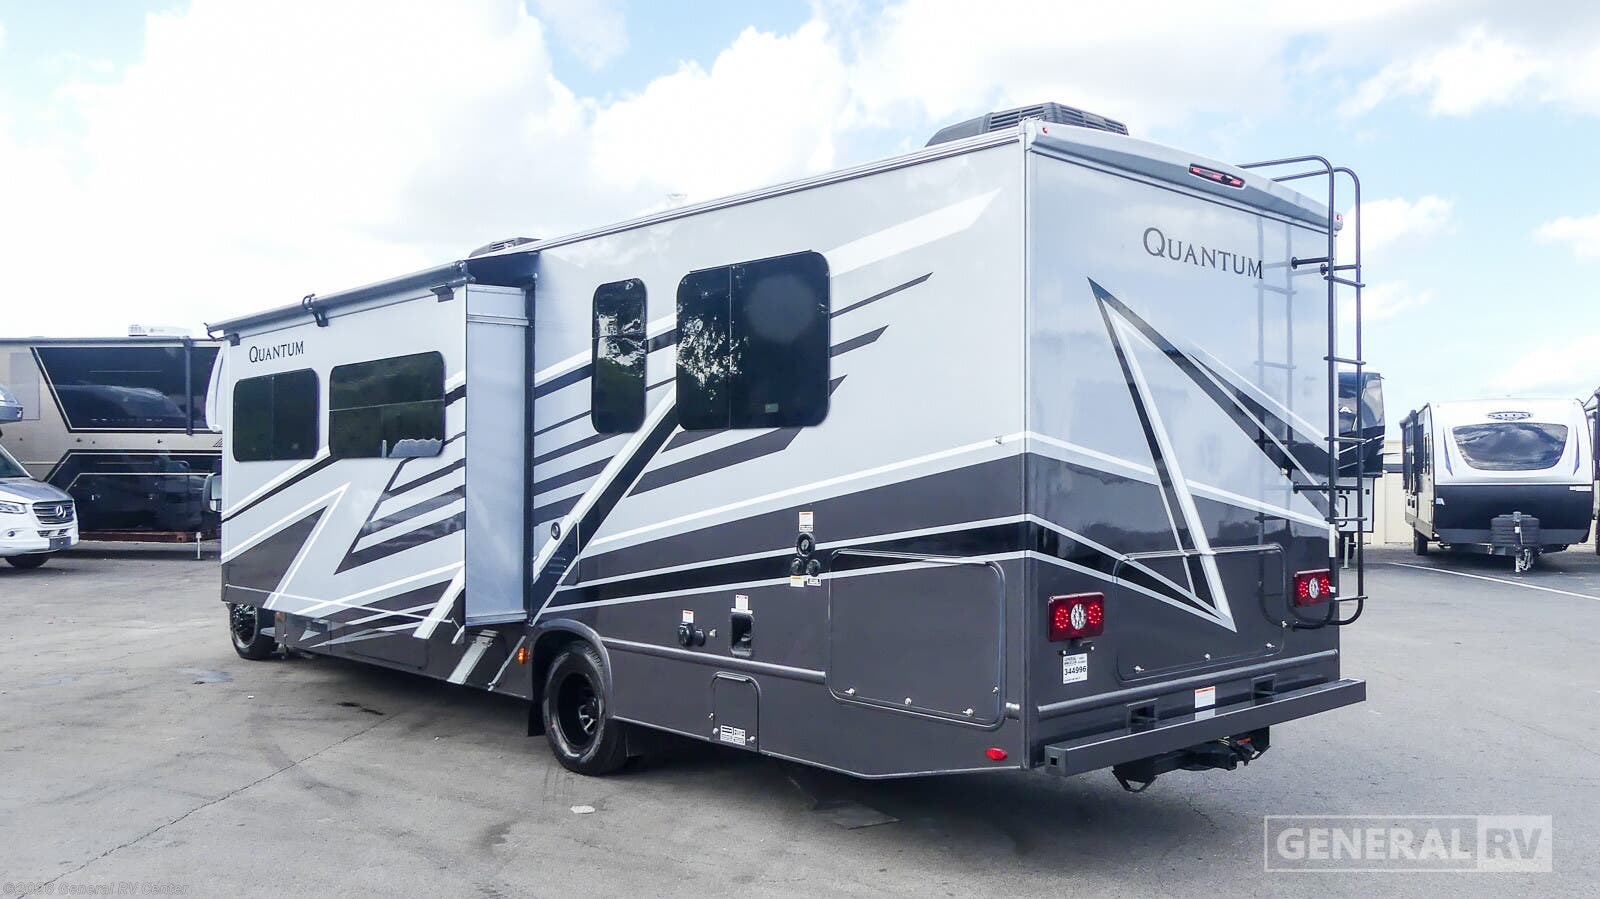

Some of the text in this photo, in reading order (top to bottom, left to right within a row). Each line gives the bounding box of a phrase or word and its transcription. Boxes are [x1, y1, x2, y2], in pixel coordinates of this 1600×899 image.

[1143, 227, 1263, 279] QUANTUM
[249, 341, 304, 363] QUANTUM
[1064, 665, 1087, 675] 344996
